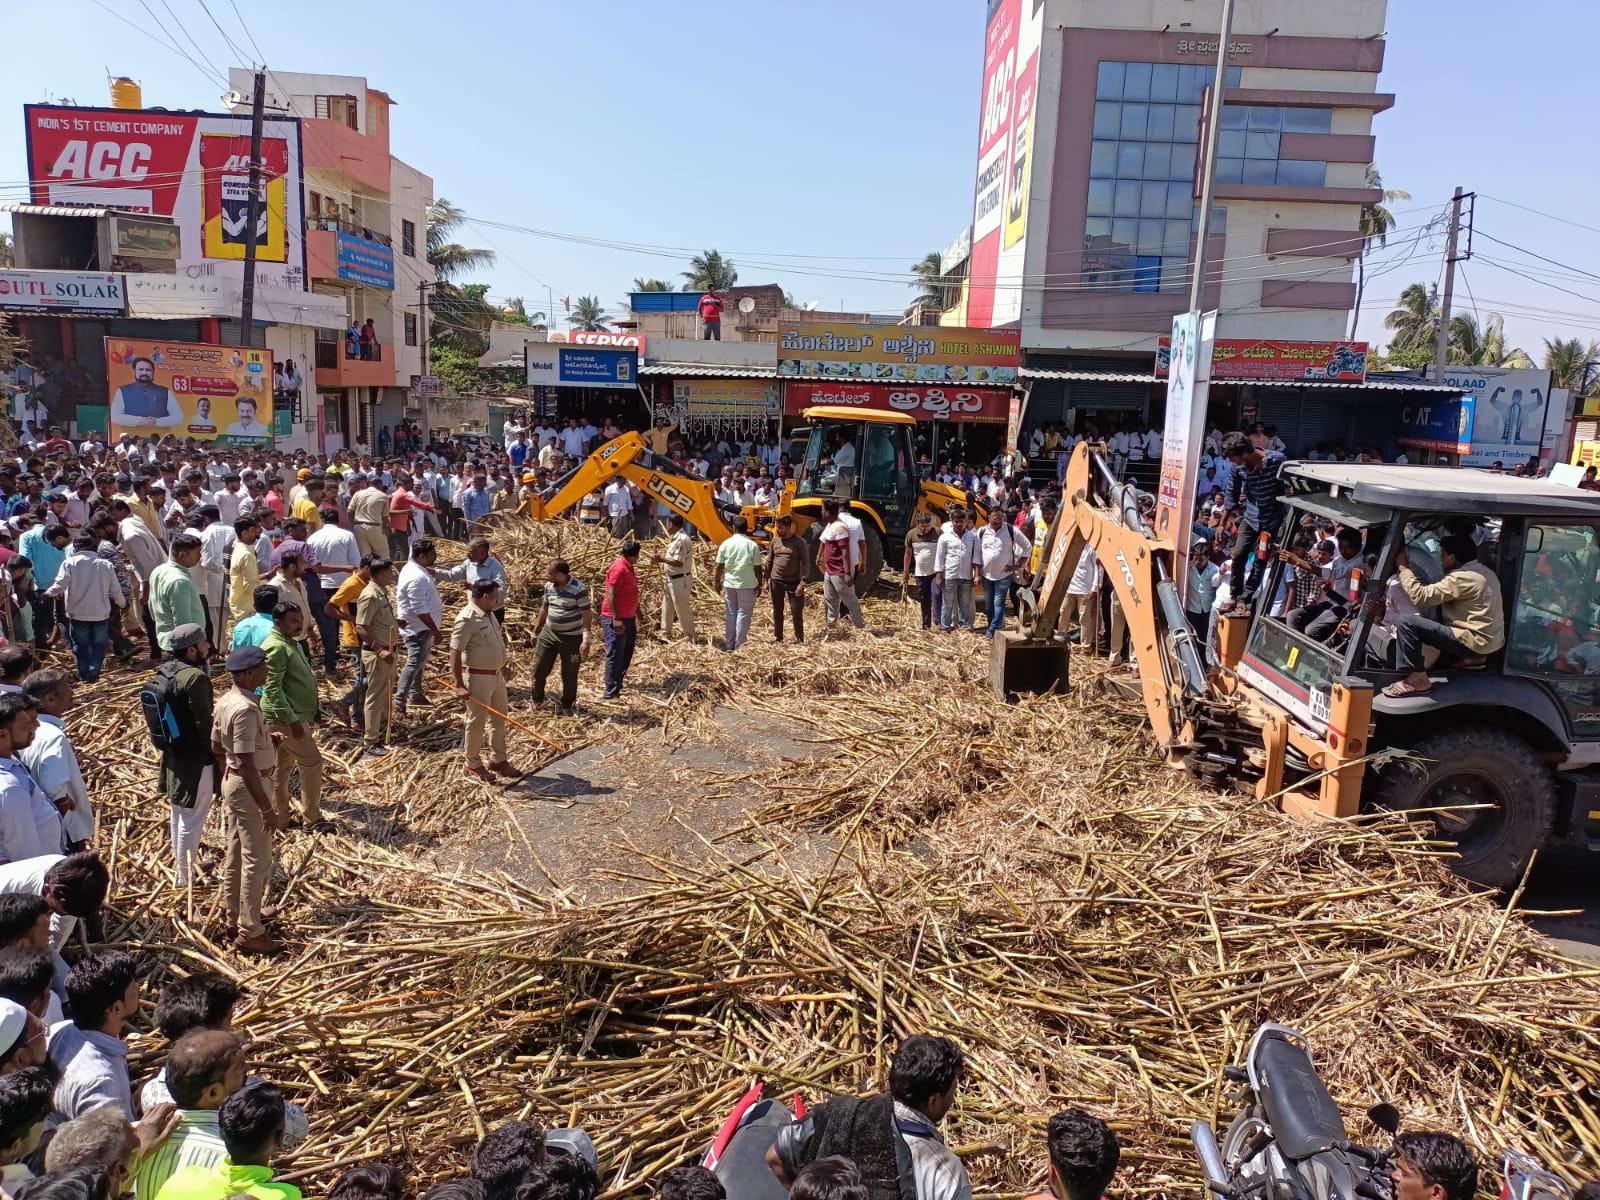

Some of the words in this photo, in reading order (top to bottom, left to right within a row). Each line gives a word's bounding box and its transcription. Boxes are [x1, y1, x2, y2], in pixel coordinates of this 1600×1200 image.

[1177, 40, 1196, 54] ಶ್ರೀ
[1197, 40, 1220, 55] ಪ್ರಭ
[980, 46, 1014, 150] ACC
[38, 117, 70, 130] INDIA'S
[73, 118, 91, 131] 1ST
[94, 120, 131, 134] CEMENT
[133, 122, 184, 136] COMPANY
[48, 140, 152, 182] ACC
[14, 280, 51, 295] UTL
[56, 282, 119, 298] SOLAR
[251, 353, 260, 362] 16
[883, 334, 936, 363] ಅಶ್ವಿನಿ
[941, 343, 968, 354] HOTEL
[974, 344, 1017, 356] ASHWINI
[174, 378, 187, 391] 63
[889, 388, 983, 419] ಅಶ್ವಿನಿ
[1402, 406, 1432, 426] CAT
[648, 476, 693, 512] JCB
[1046, 532, 1066, 592] CASE
